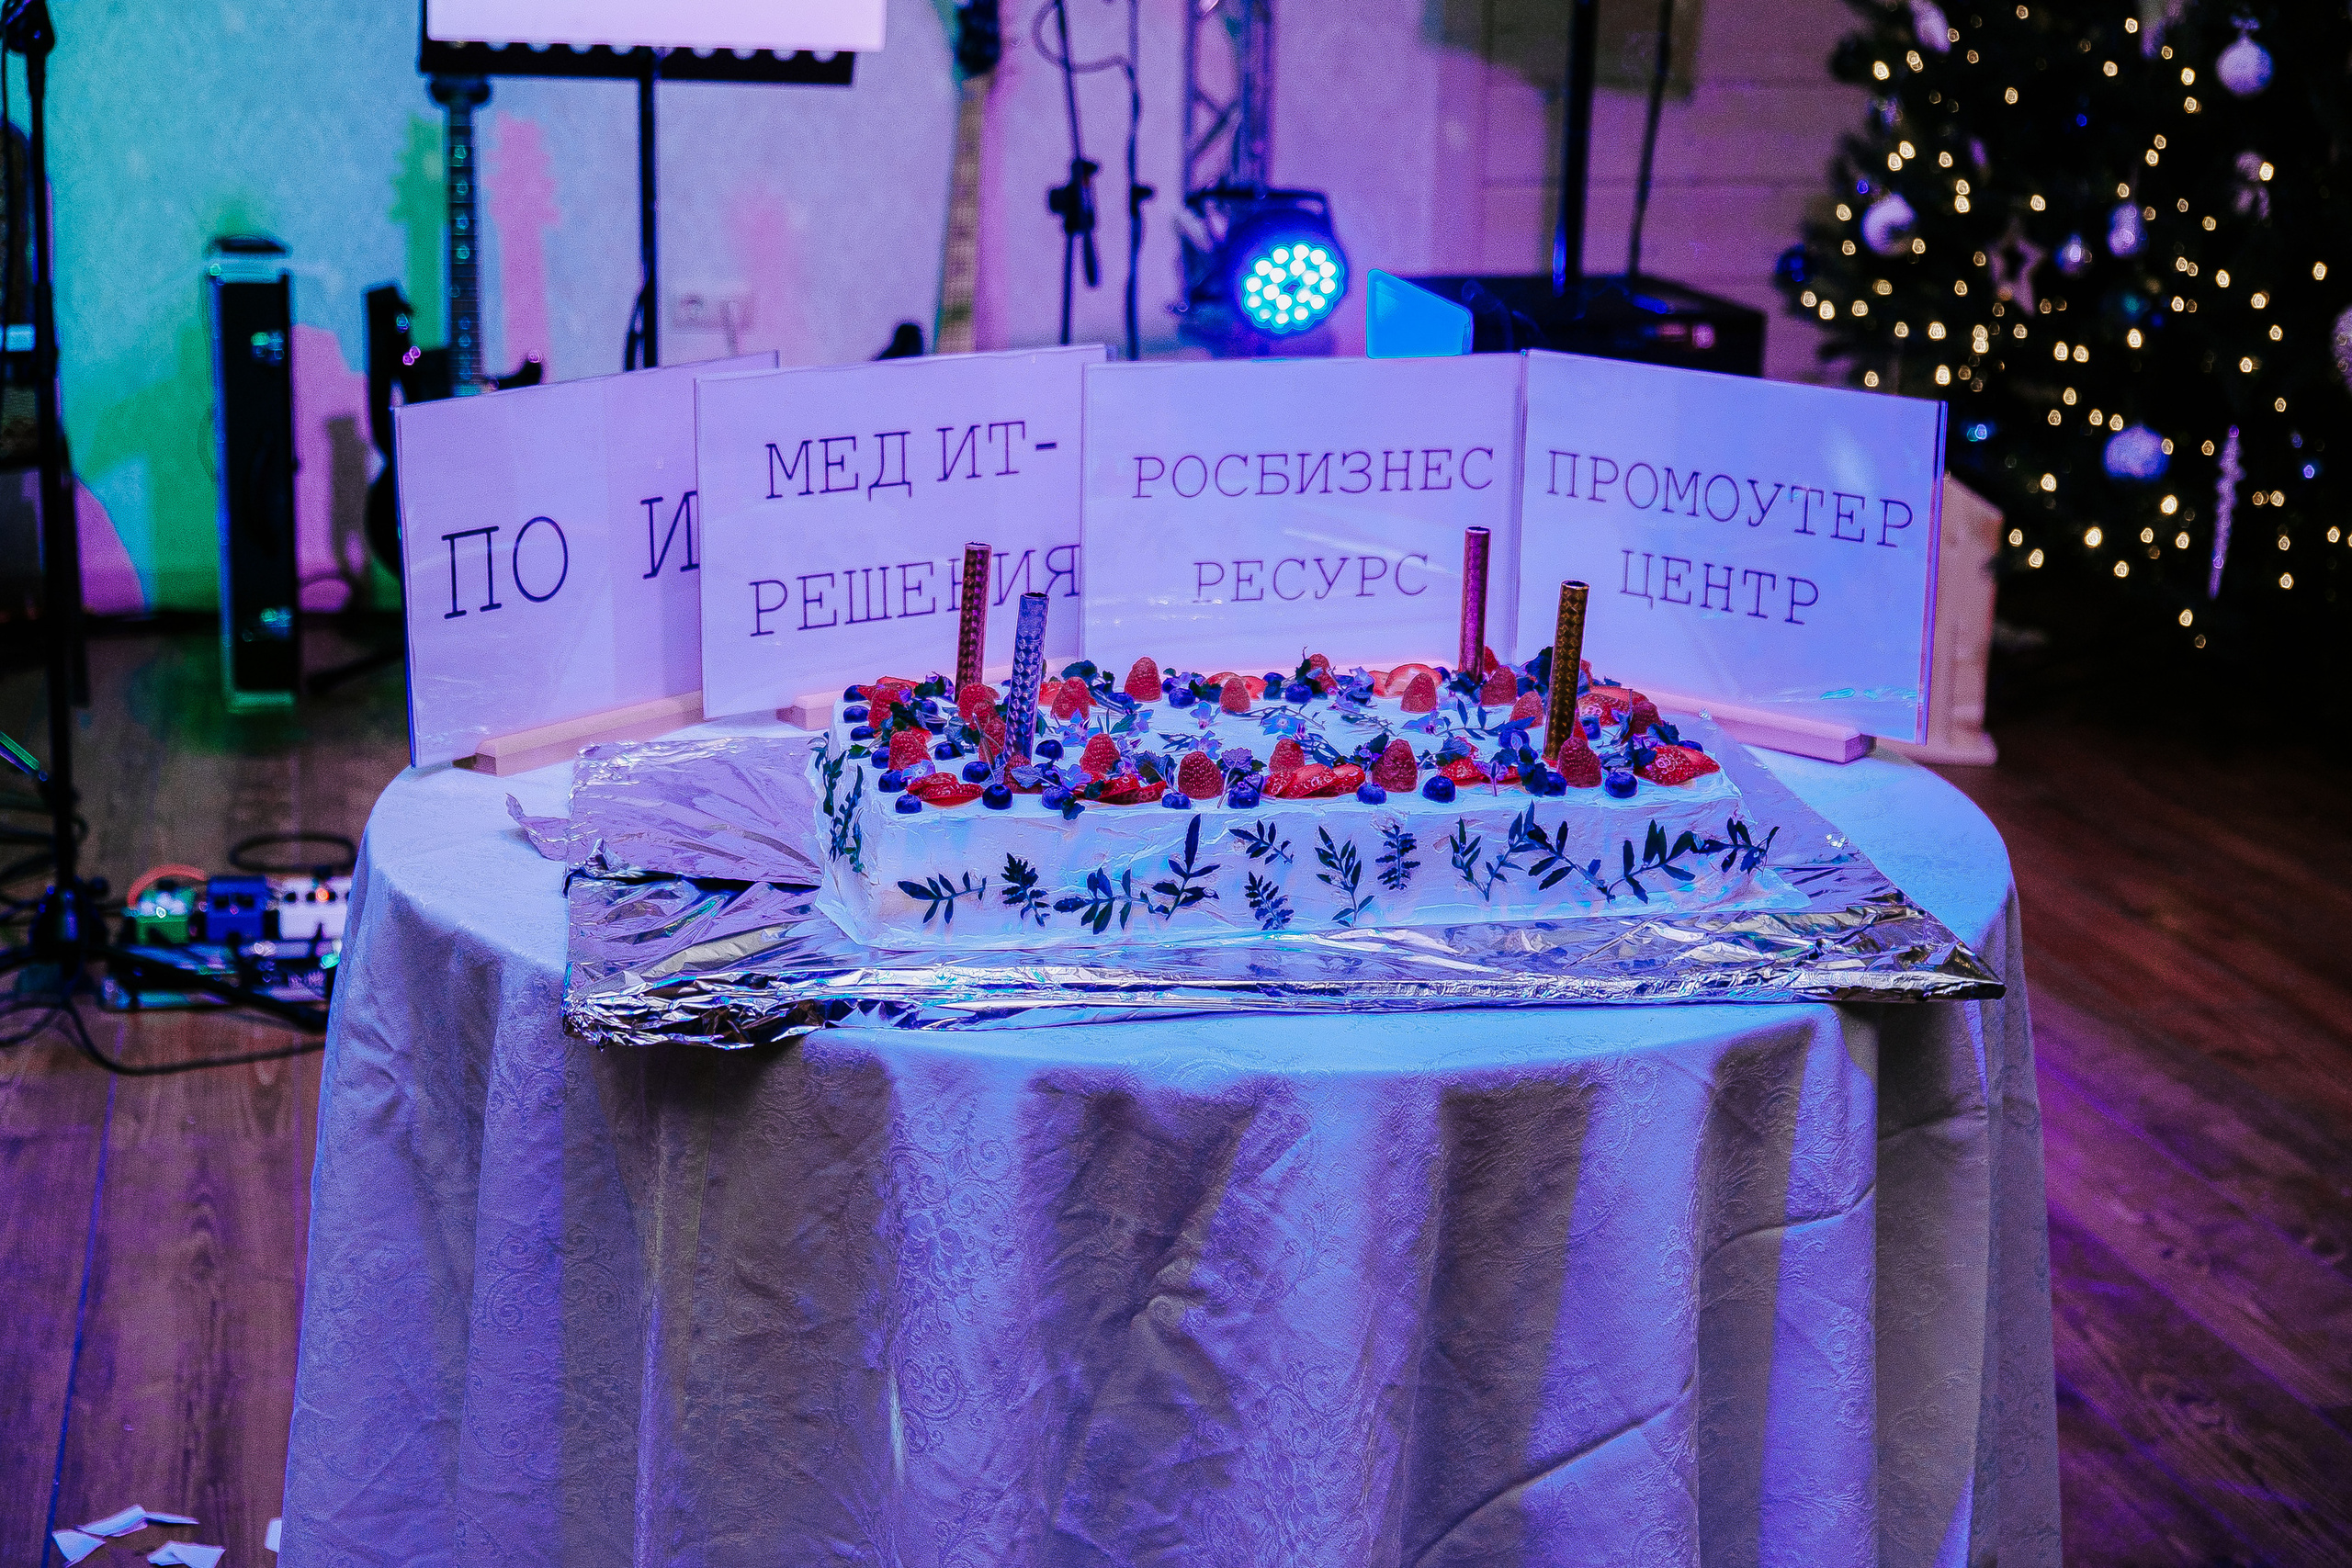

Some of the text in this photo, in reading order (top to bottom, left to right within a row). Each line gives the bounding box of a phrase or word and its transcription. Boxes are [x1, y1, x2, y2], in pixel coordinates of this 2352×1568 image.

[764, 420, 1057, 502] МЕД ИТ-
[1131, 446, 1495, 499] РОСБИЗНЕС
[1546, 448, 1915, 548] ПРОМОУТЕР
[441, 515, 570, 620] ПО
[1193, 553, 1430, 604] РЕСУРС
[1619, 549, 1820, 626] ЦЕНТР
